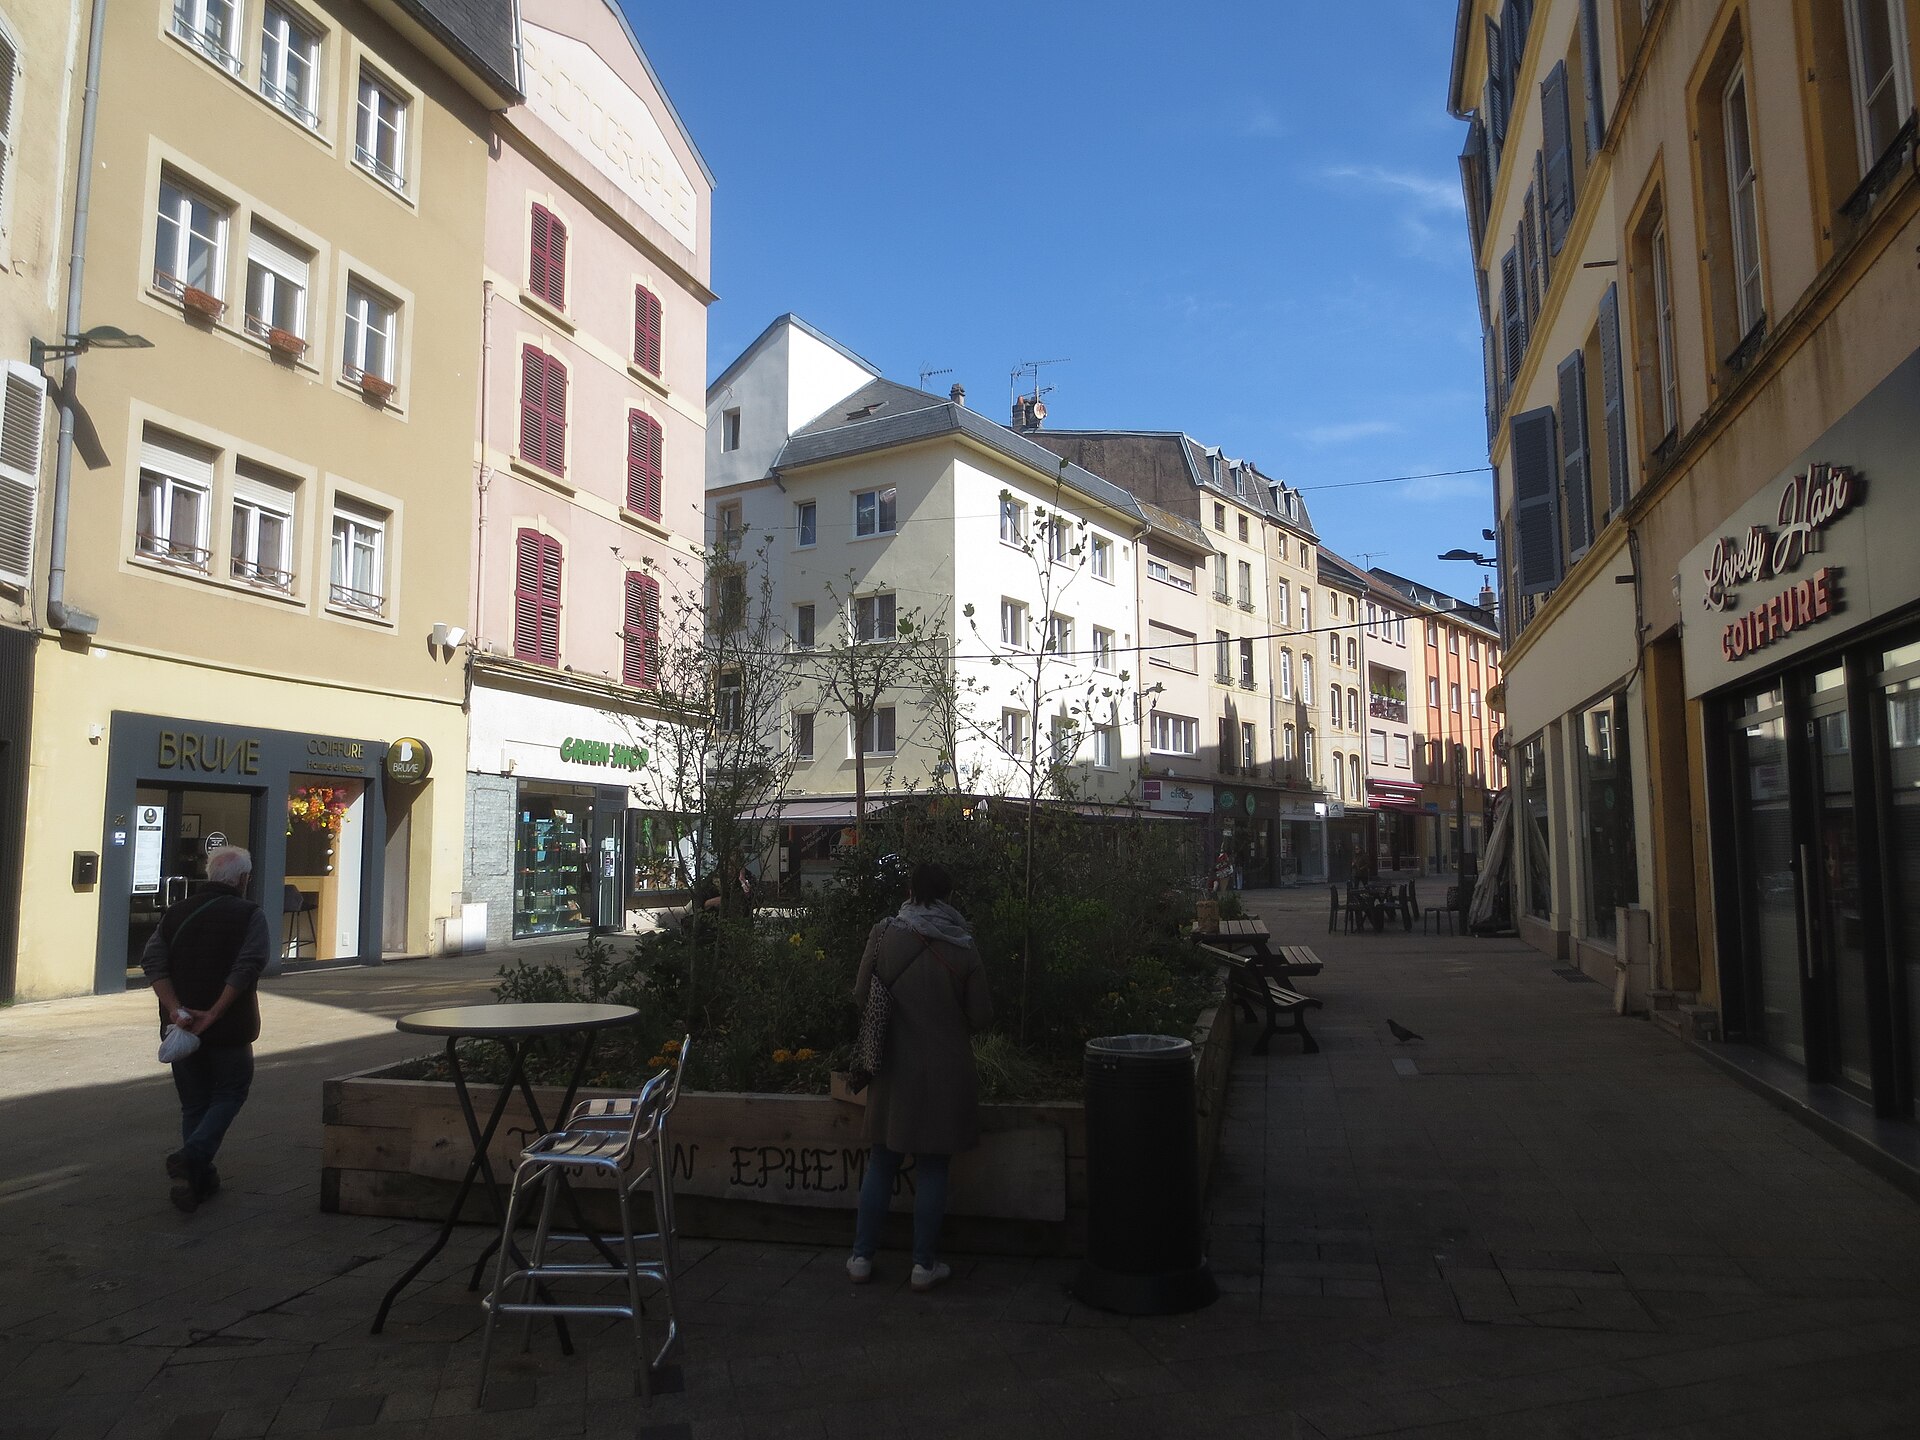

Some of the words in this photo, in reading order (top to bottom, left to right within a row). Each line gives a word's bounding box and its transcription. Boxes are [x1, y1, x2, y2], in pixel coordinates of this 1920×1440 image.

[1703, 526, 1767, 613] Lovely
[1772, 463, 1849, 575] Hair
[1721, 566, 1831, 662] COIFFURE
[158, 730, 260, 775] BRUNE
[307, 739, 365, 759] COIFFURE
[392, 763, 419, 773] BRUNE
[560, 737, 610, 766] GREEN
[611, 743, 649, 770] SHOP
[729, 1146, 917, 1196] EPHEMR
